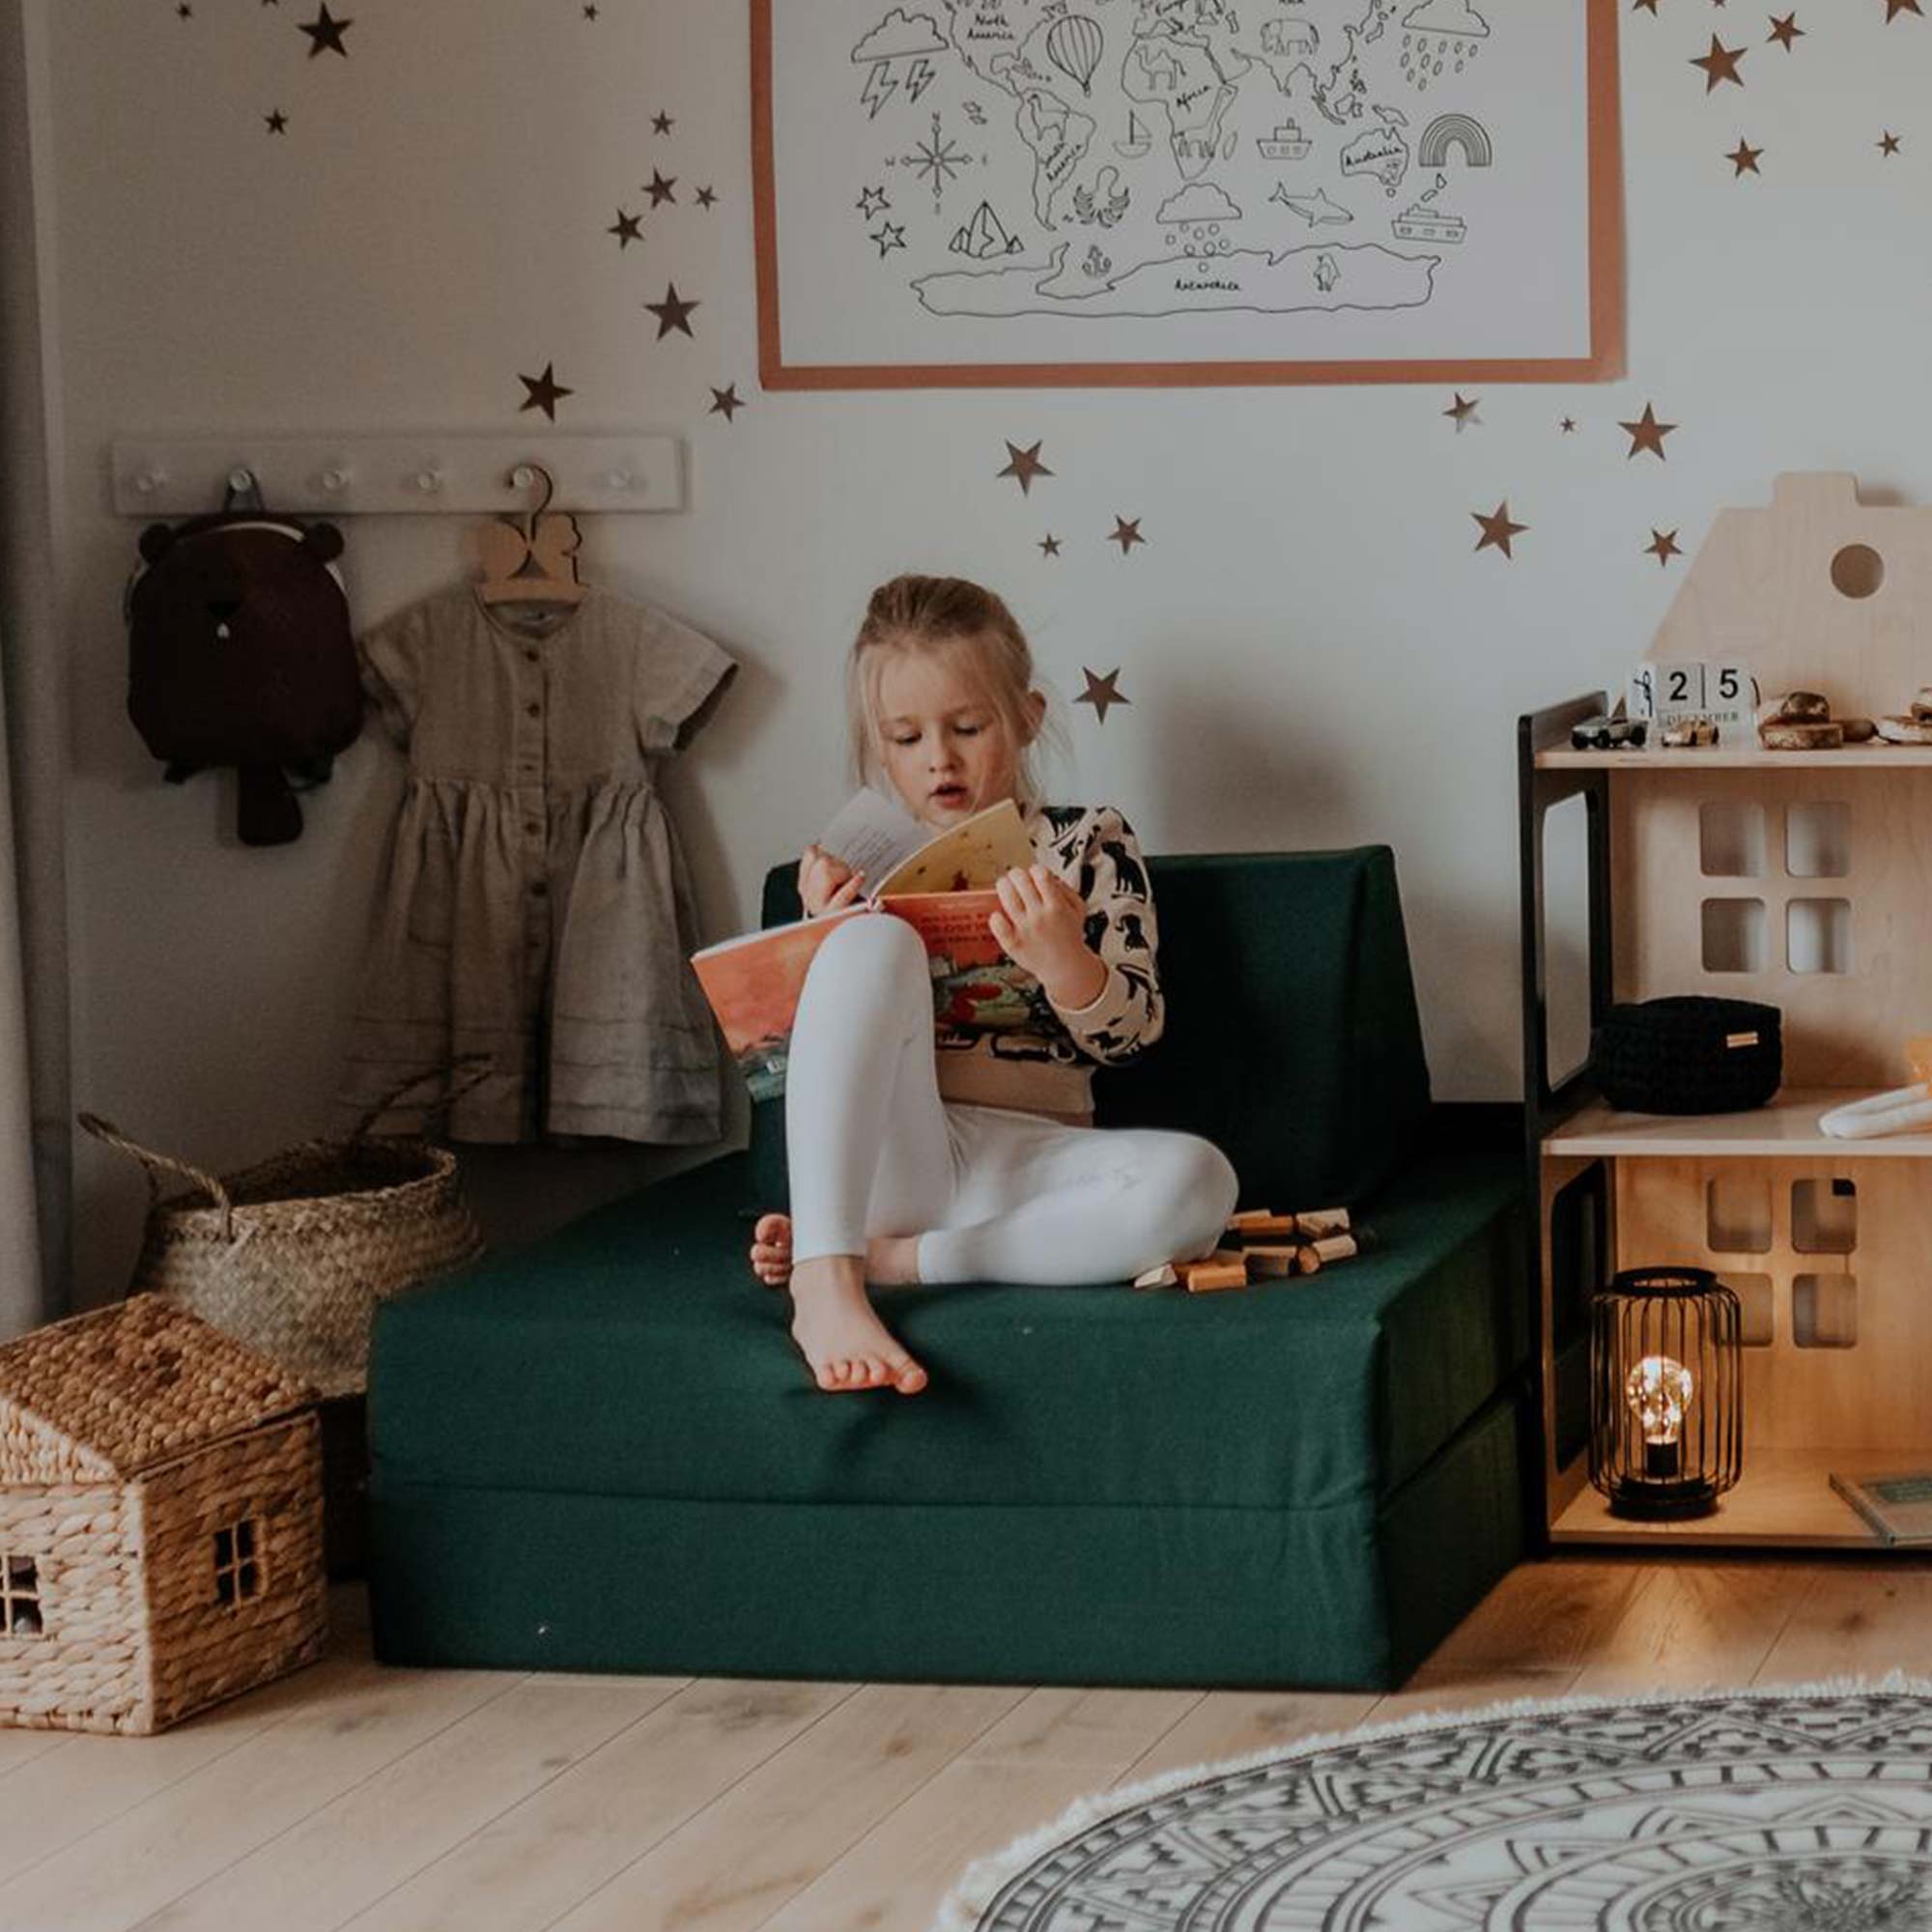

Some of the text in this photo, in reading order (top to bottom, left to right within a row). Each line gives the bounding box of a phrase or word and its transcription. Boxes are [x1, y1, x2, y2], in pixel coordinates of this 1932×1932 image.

[1176, 85, 1212, 114] Africa
[1346, 146, 1404, 167] Australia
[1175, 278, 1242, 292] Antarctica
